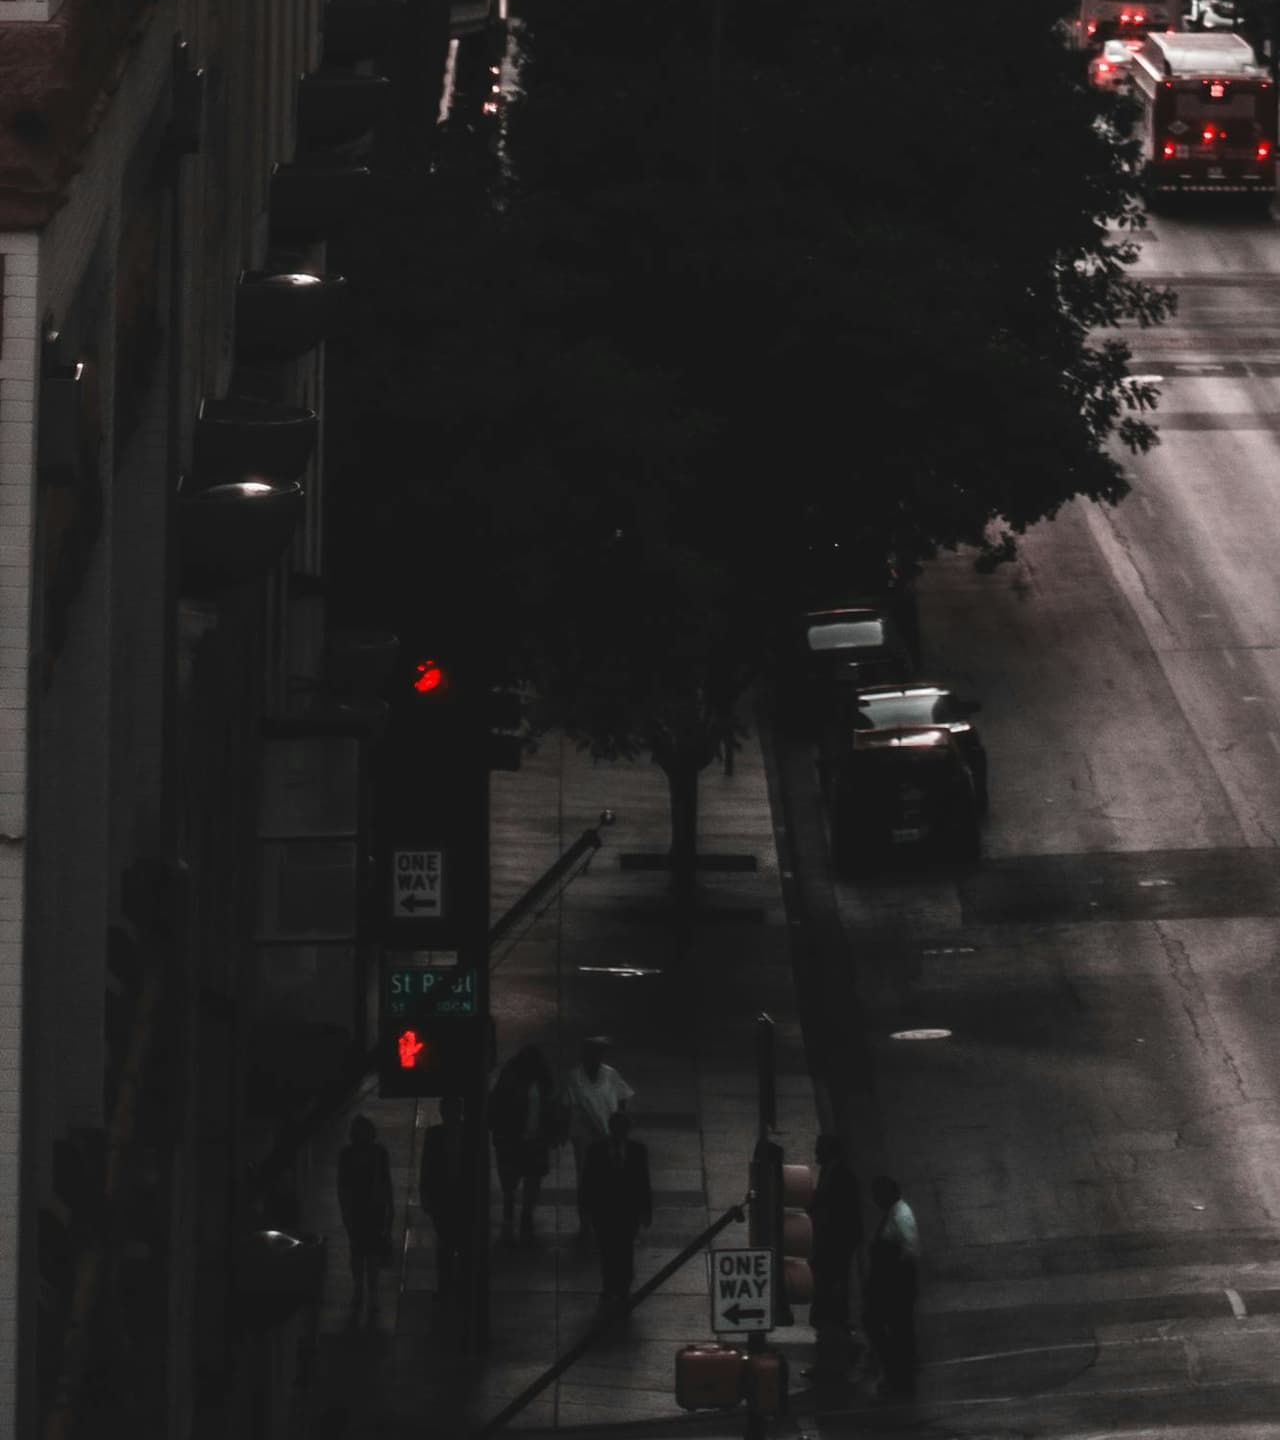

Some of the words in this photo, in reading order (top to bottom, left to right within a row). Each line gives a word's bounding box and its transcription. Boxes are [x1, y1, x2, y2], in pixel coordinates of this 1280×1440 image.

[398, 855, 438, 872] ONE
[398, 874, 439, 891] WAY
[391, 973, 412, 993] St
[720, 1255, 767, 1276] ONE
[720, 1279, 767, 1299] WAY
